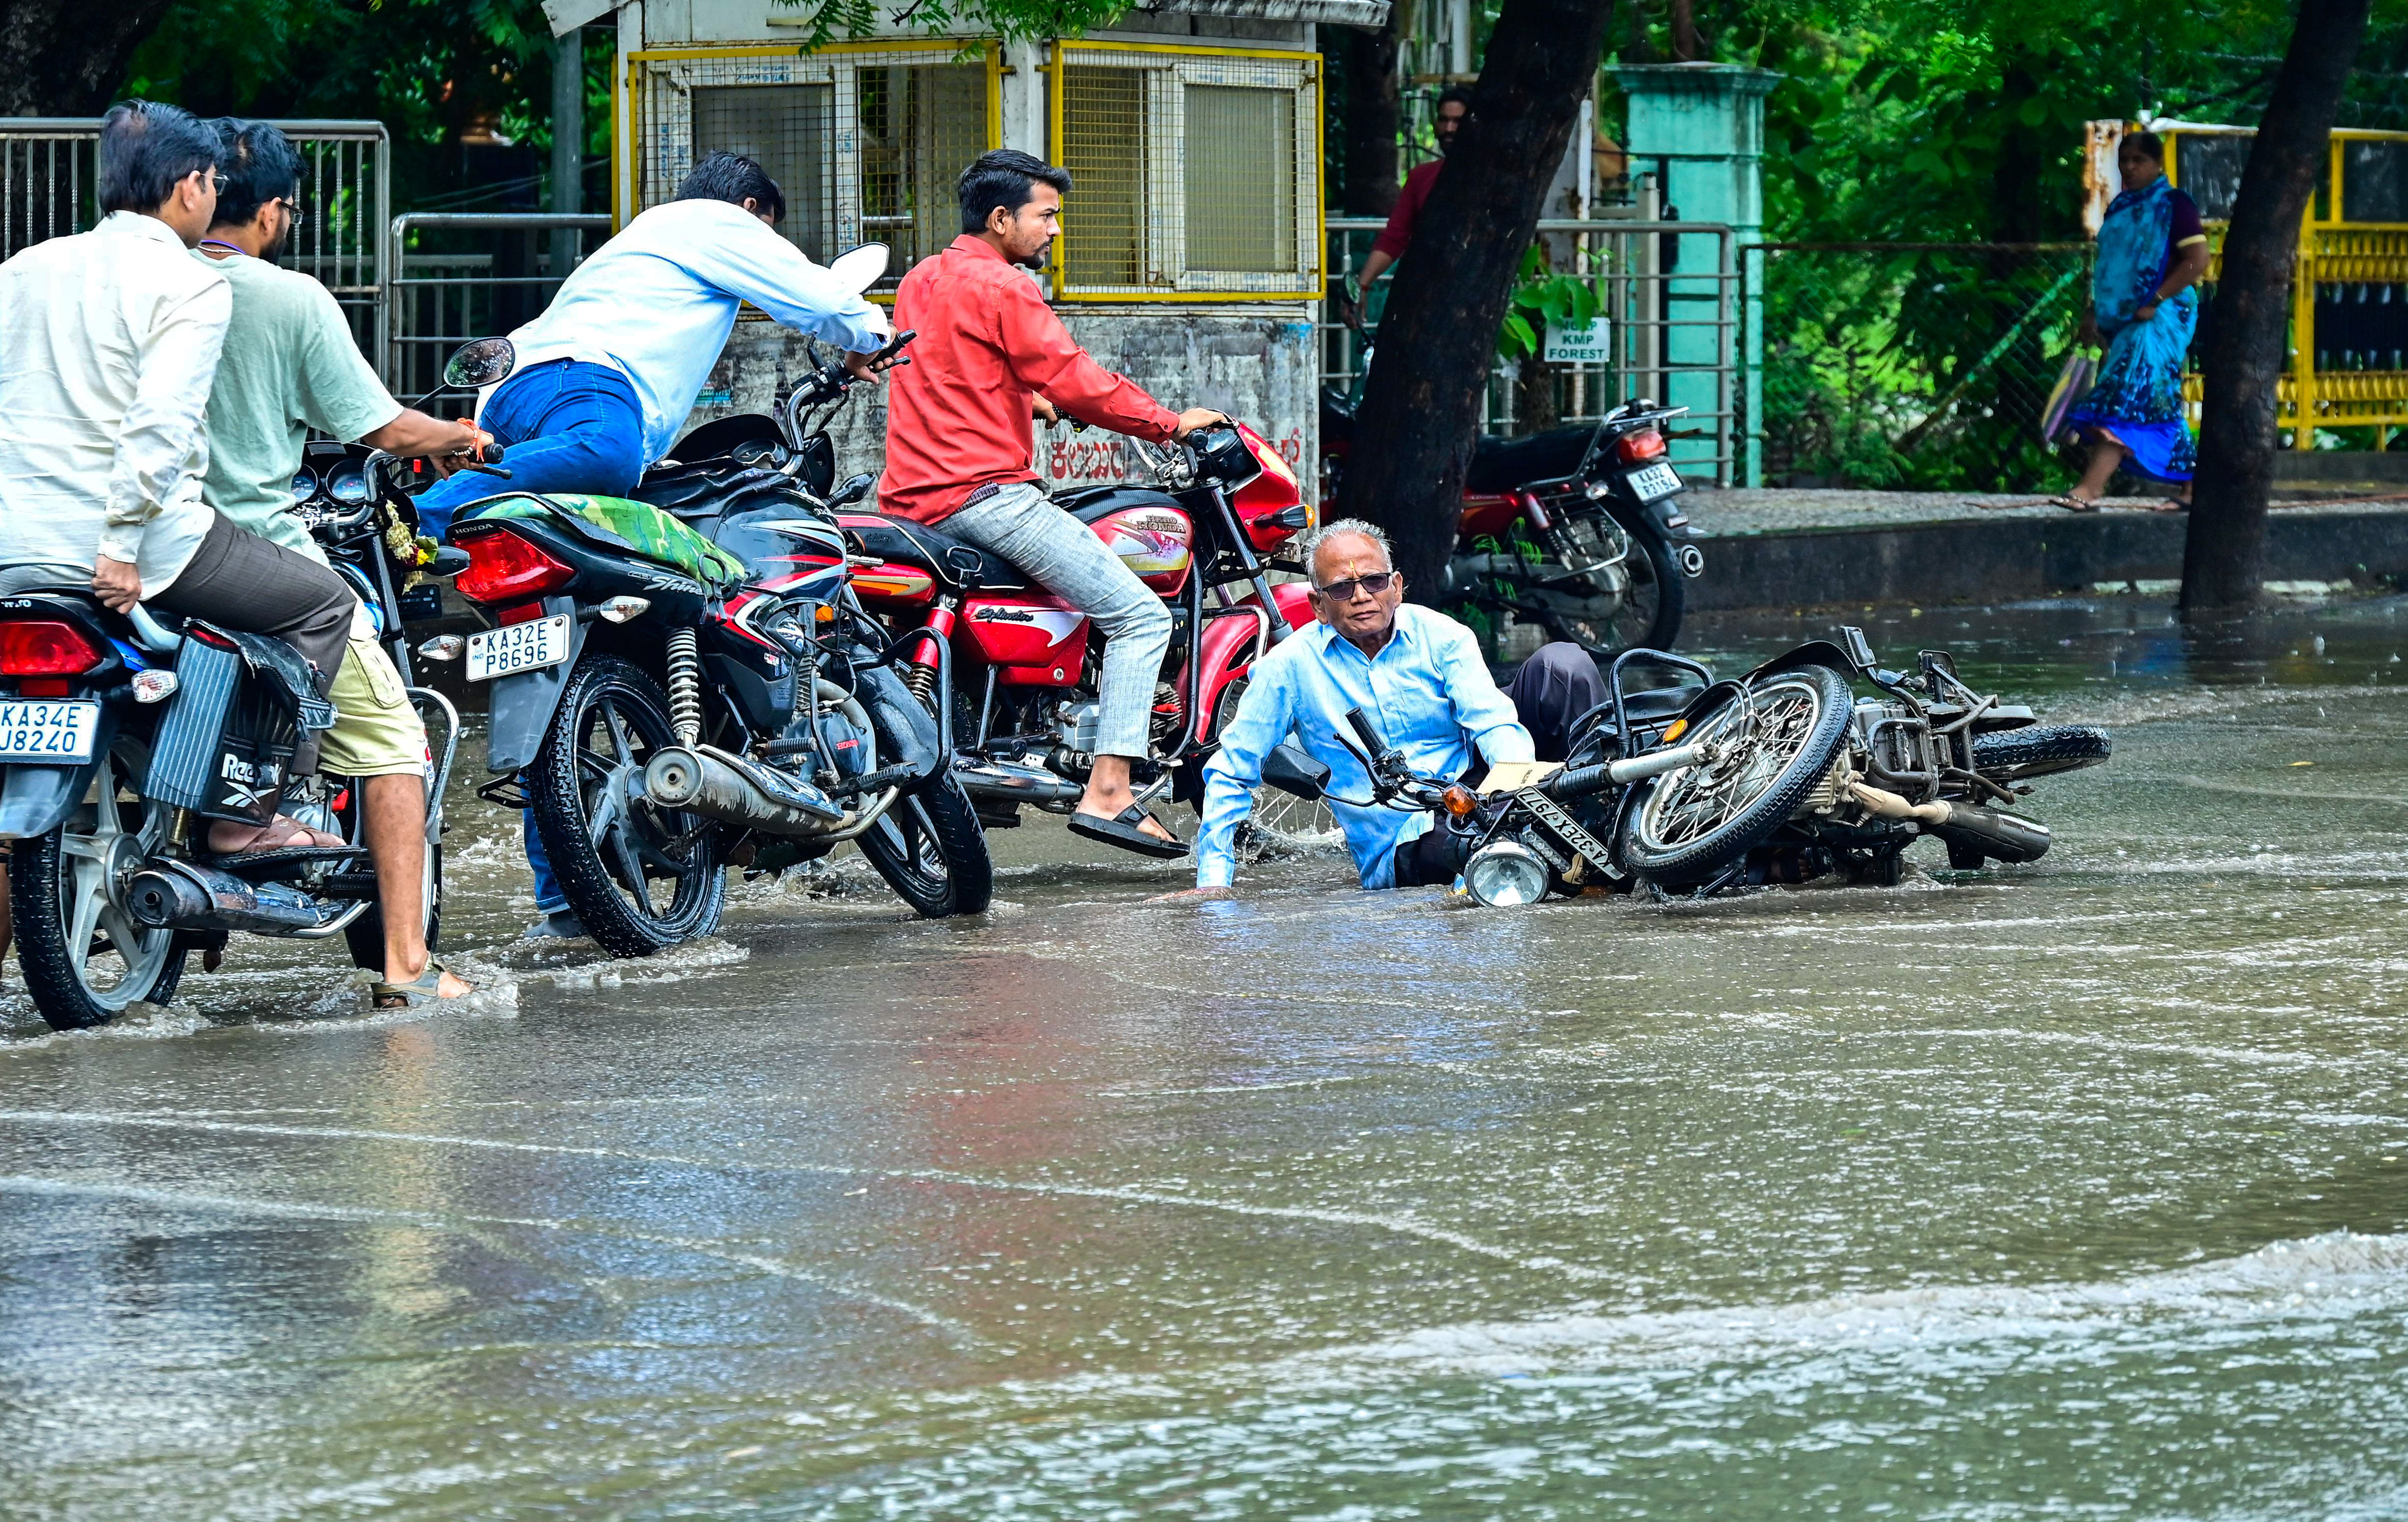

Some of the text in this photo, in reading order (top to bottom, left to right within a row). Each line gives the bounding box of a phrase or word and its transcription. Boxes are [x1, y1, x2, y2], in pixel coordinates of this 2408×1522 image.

[1562, 335, 1594, 344] KMP
[1549, 348, 1605, 359] FOREST
[1146, 515, 1177, 524] HERO
[454, 523, 494, 534] HONDA
[1137, 521, 1186, 533] HONDA
[642, 576, 705, 595] Shine
[487, 621, 548, 653] KA32E
[486, 643, 547, 675] P8696
[1, 705, 81, 728] KA34E
